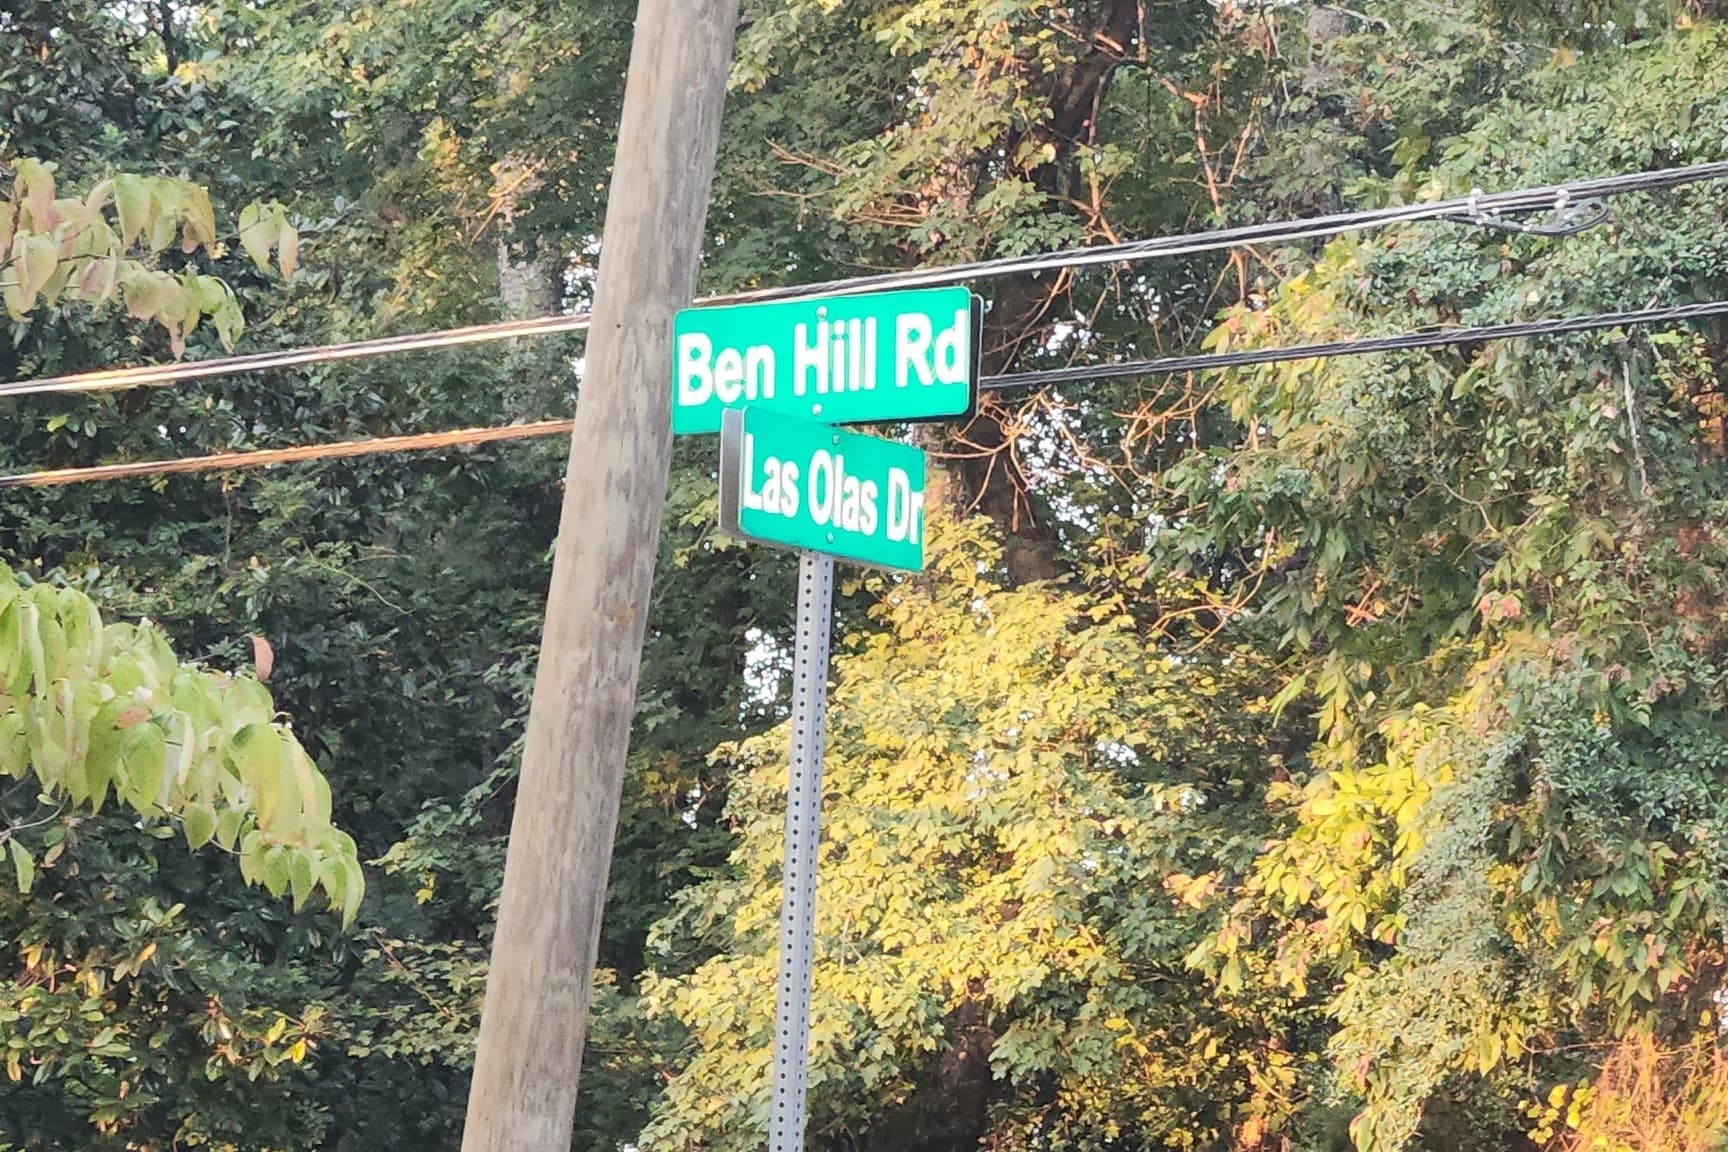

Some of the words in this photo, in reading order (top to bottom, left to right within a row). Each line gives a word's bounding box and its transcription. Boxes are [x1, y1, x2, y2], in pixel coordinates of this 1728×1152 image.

[677, 331, 776, 407] Ben
[793, 316, 878, 396] Hill
[895, 308, 969, 387] Rd
[742, 432, 800, 518] Las
[808, 449, 878, 536] Olas
[886, 467, 924, 545] Dr
